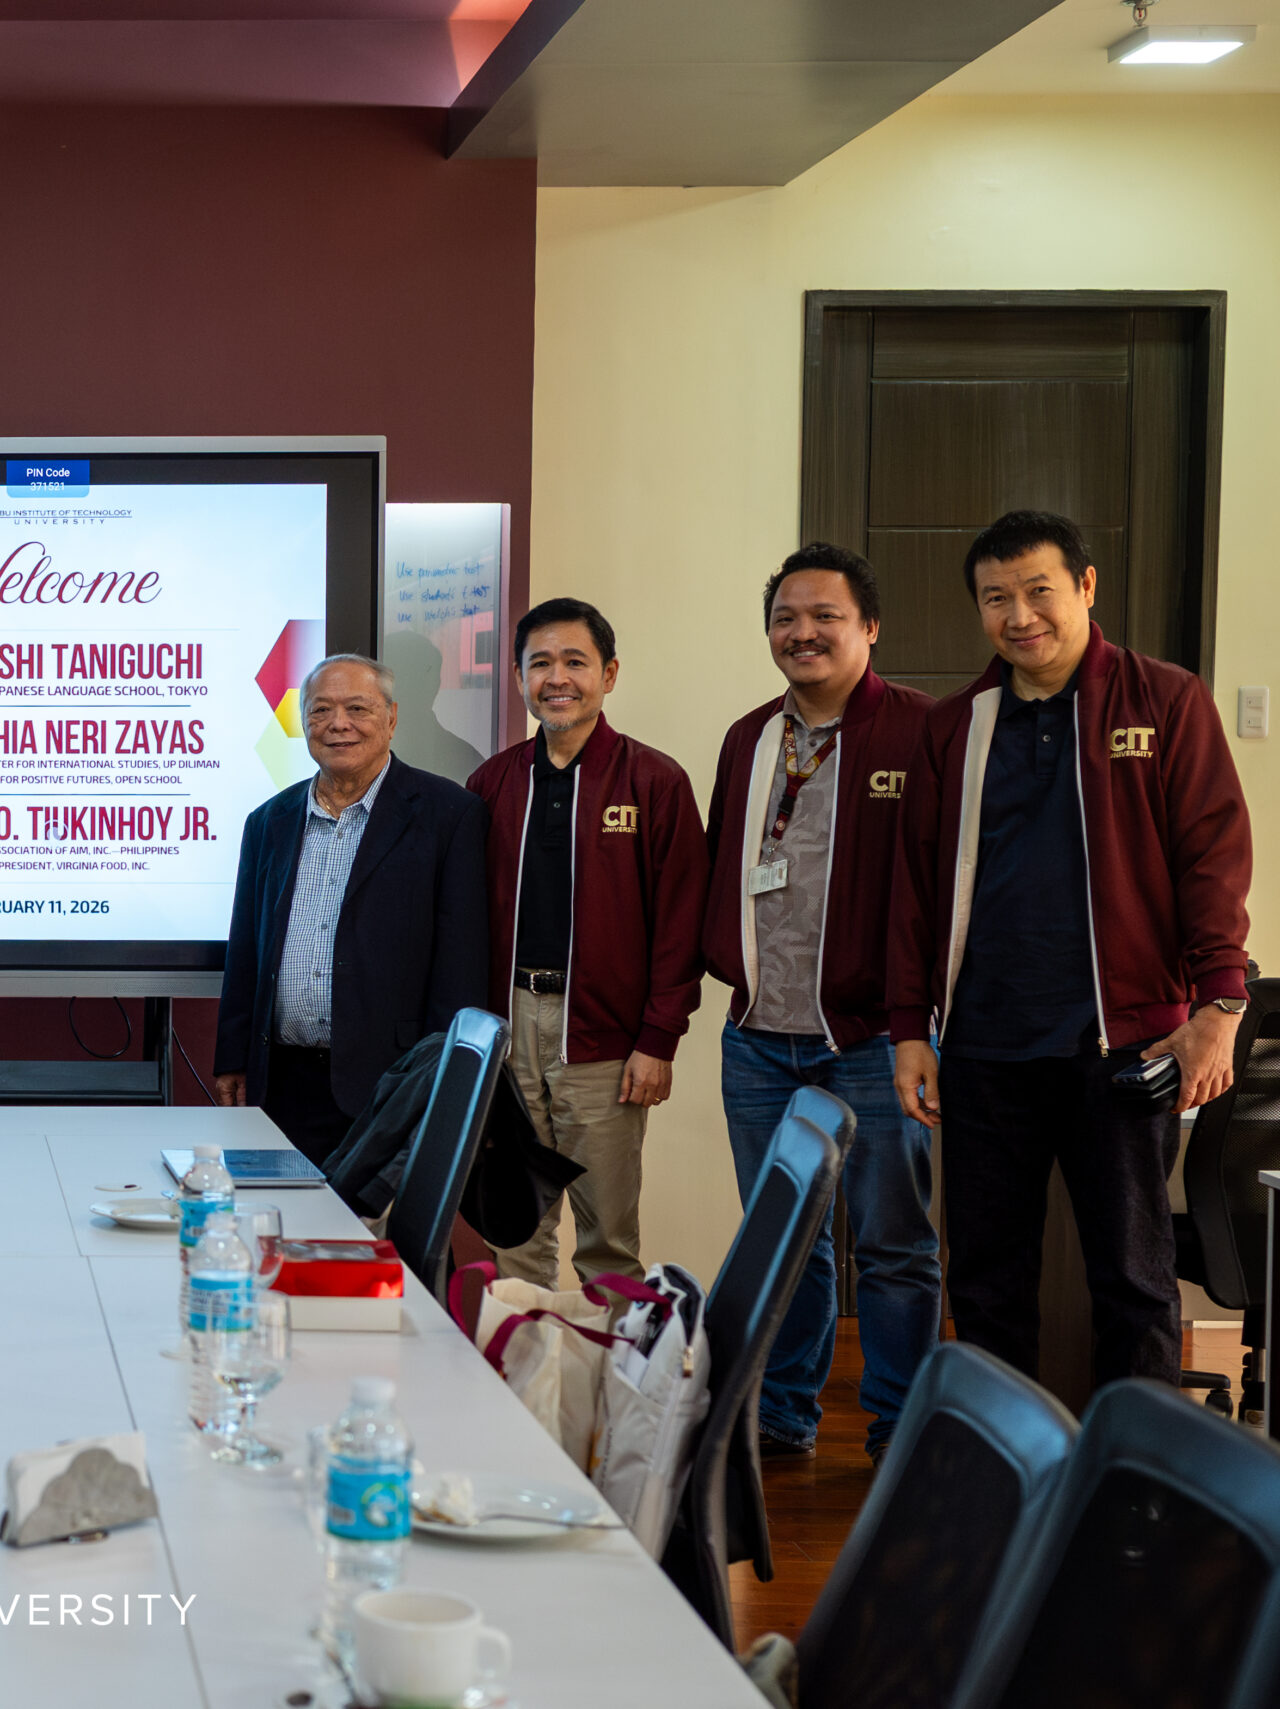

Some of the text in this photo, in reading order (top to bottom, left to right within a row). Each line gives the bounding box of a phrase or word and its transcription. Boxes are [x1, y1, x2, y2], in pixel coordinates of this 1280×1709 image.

[27, 468, 70, 477] PIN Code
[30, 482, 65, 491] 371521
[52, 643, 202, 679] TANIGUCHI
[48, 686, 112, 696] LANGUAGE
[114, 686, 164, 698] SCHOOL,
[167, 686, 208, 696] TOKYO
[46, 720, 106, 754] NERI
[115, 720, 204, 754] ZAYAS
[1110, 727, 1156, 752] CIT
[16, 760, 35, 769] FOR
[38, 760, 115, 769] INTERNATIONAL
[117, 760, 161, 770] STUDIES,
[163, 760, 176, 769] UP
[179, 760, 220, 769] DILIMAN
[0, 775, 19, 784] FOR
[22, 775, 64, 784] POSITIVE
[67, 775, 114, 786] FUTURES,
[115, 775, 141, 784] OPEN
[144, 775, 182, 784] SCHOOL
[602, 805, 640, 827] CIT
[27, 806, 173, 840] TIUKINHOY
[180, 806, 217, 840] JR.
[55, 846, 67, 855] OF
[69, 846, 91, 856] AIM,
[0, 861, 55, 871] PRESIDENT,
[56, 861, 98, 870] VIRGINIA
[101, 861, 129, 871] FOOD,
[132, 861, 150, 870] INC.
[48, 900, 67, 917] 11,
[70, 900, 110, 914] 2026
